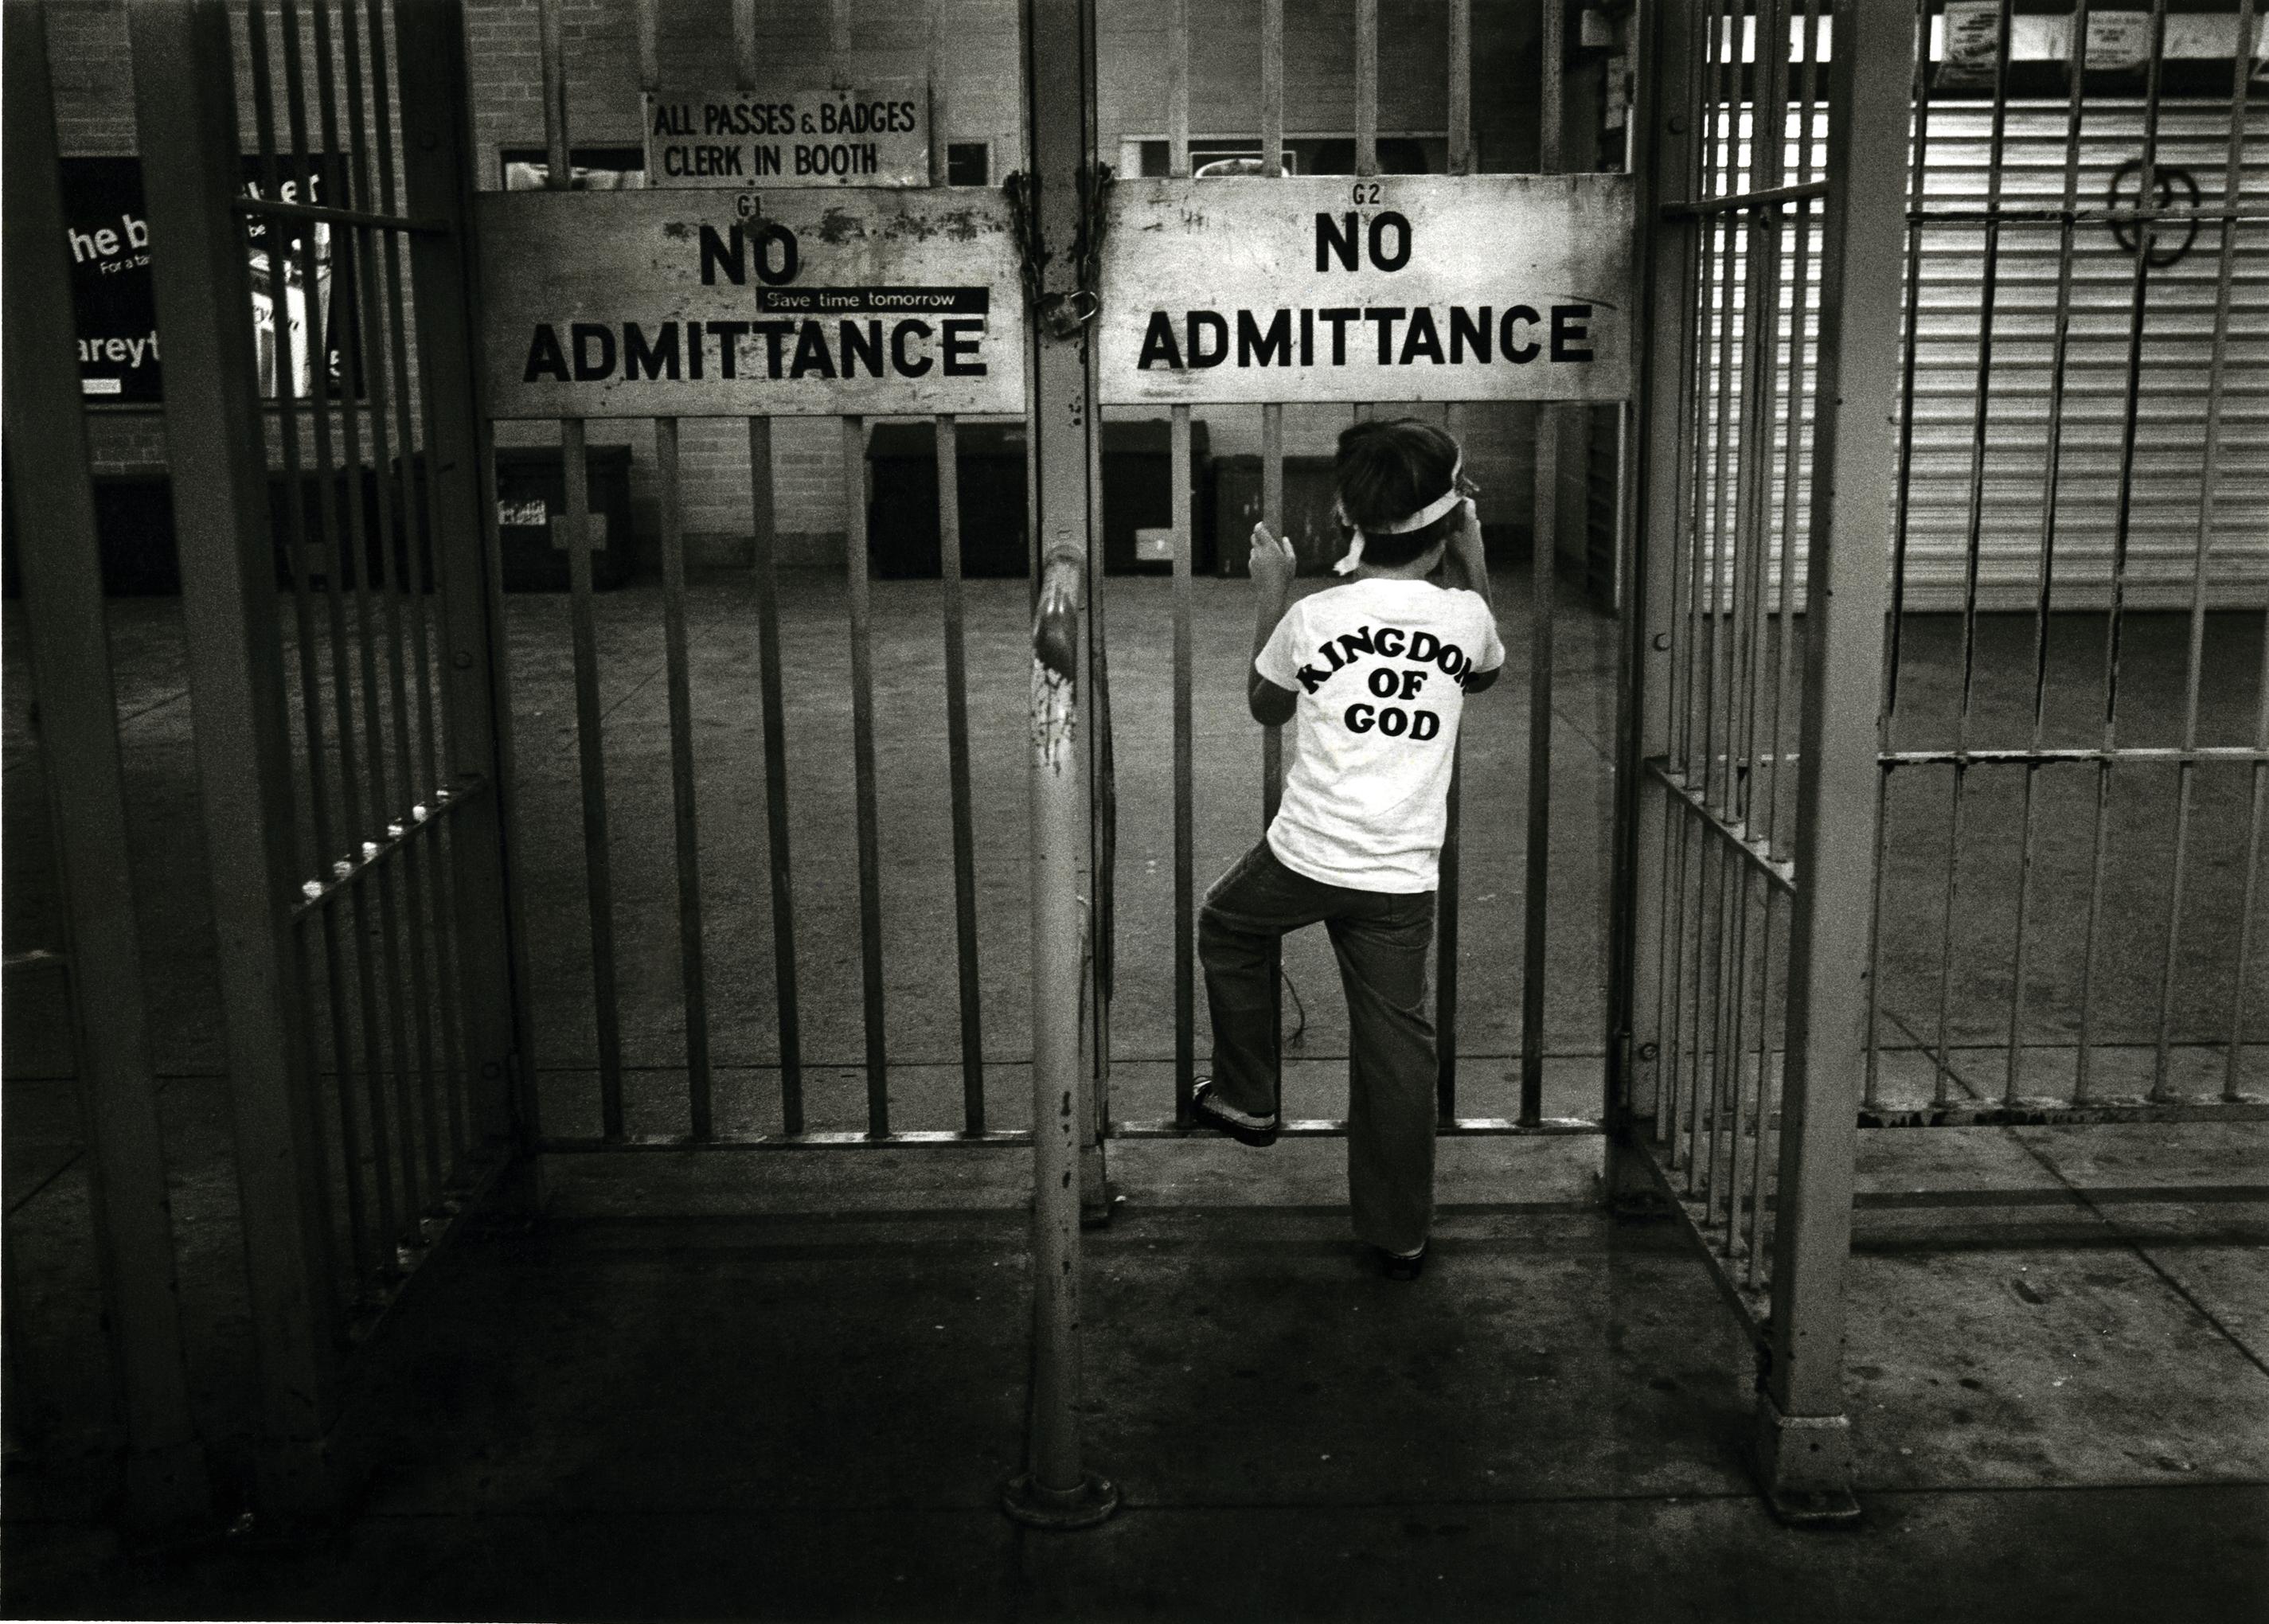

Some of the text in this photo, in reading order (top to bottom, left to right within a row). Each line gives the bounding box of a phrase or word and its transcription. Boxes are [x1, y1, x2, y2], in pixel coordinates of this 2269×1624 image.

[654, 101, 916, 135] ALL PASSES & BADGES
[664, 143, 877, 177] CLERK IN BOOTH
[737, 194, 761, 217] G1
[1352, 183, 1381, 205] G2
[699, 224, 798, 286] NO
[1314, 210, 1412, 272] NO
[767, 290, 956, 309] Save time tomorrow
[522, 318, 987, 383] ADMITTANCE
[1137, 303, 1594, 370] ADMITTANCE
[1368, 667, 1428, 701] OF
[1344, 703, 1440, 741] GOD
